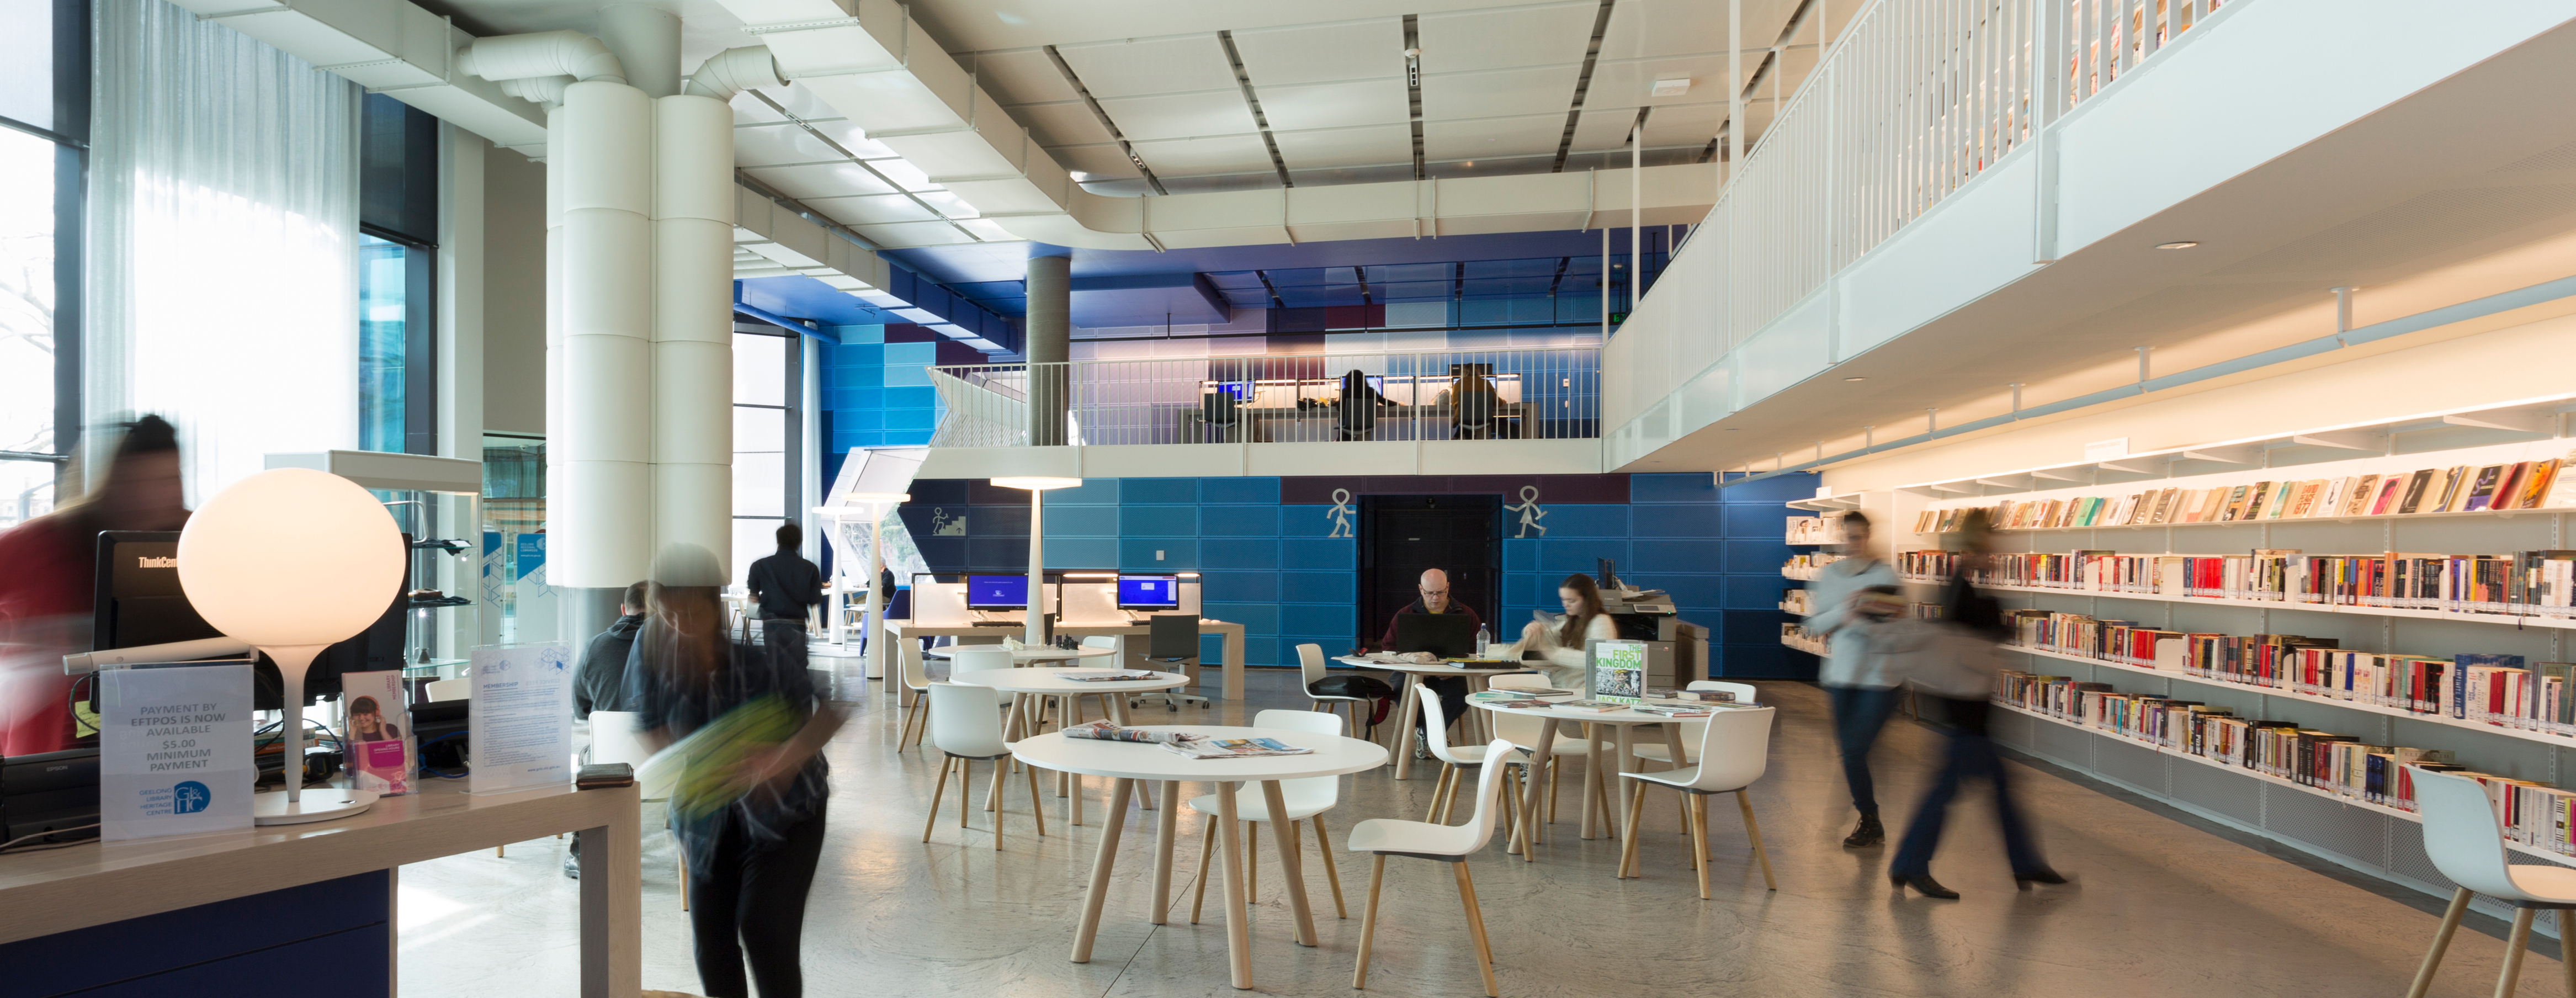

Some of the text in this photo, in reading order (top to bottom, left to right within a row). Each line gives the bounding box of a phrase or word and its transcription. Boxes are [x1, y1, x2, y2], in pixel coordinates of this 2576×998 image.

[2298, 493, 2315, 503] PEACE
[139, 556, 177, 568] ThinkCen
[1613, 650, 1641, 660] FIRST
[1596, 657, 1641, 669] KINGDOM
[140, 703, 217, 715] PAYMENT BY
[131, 713, 226, 726] EFTPOS IS NOW
[146, 725, 211, 737] AVAILABLE
[162, 739, 195, 750] $5.00
[147, 749, 211, 761] MINIMUM
[150, 760, 209, 771] PAYMENT
